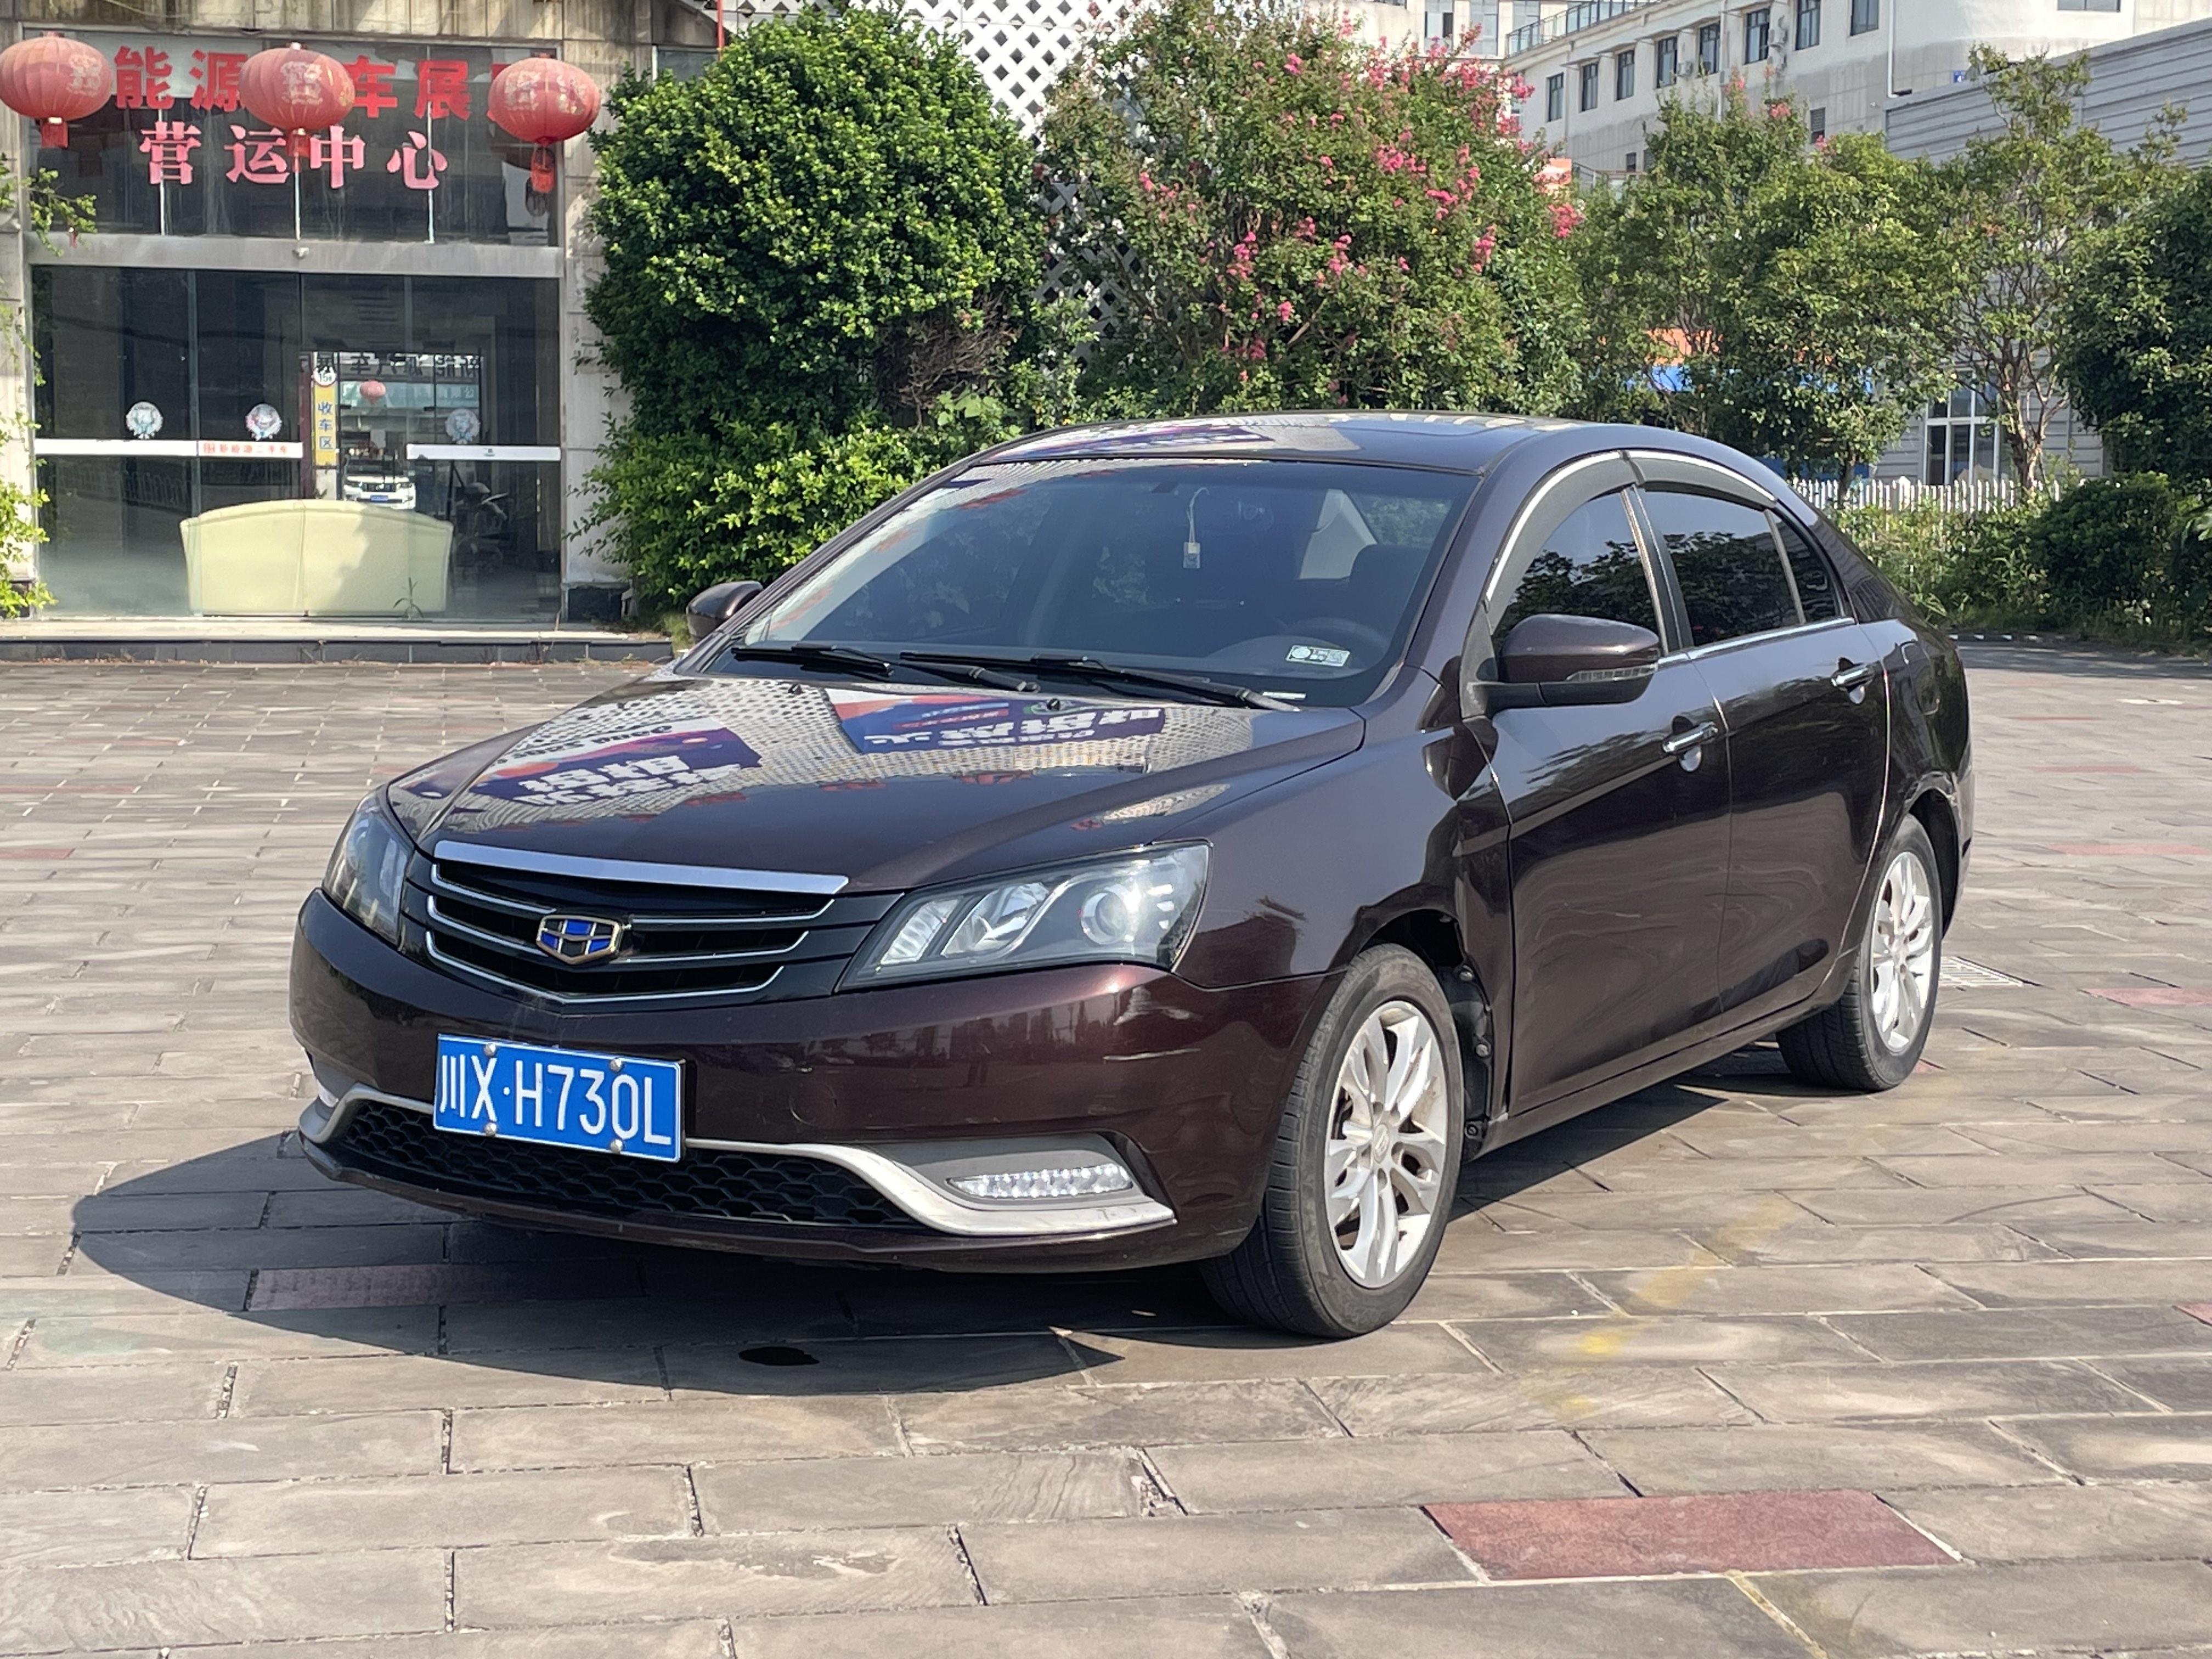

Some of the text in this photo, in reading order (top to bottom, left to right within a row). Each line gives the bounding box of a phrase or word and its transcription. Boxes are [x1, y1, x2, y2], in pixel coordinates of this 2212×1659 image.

[139, 121, 448, 189] 营运中心
[317, 400, 333, 449] 收车区
